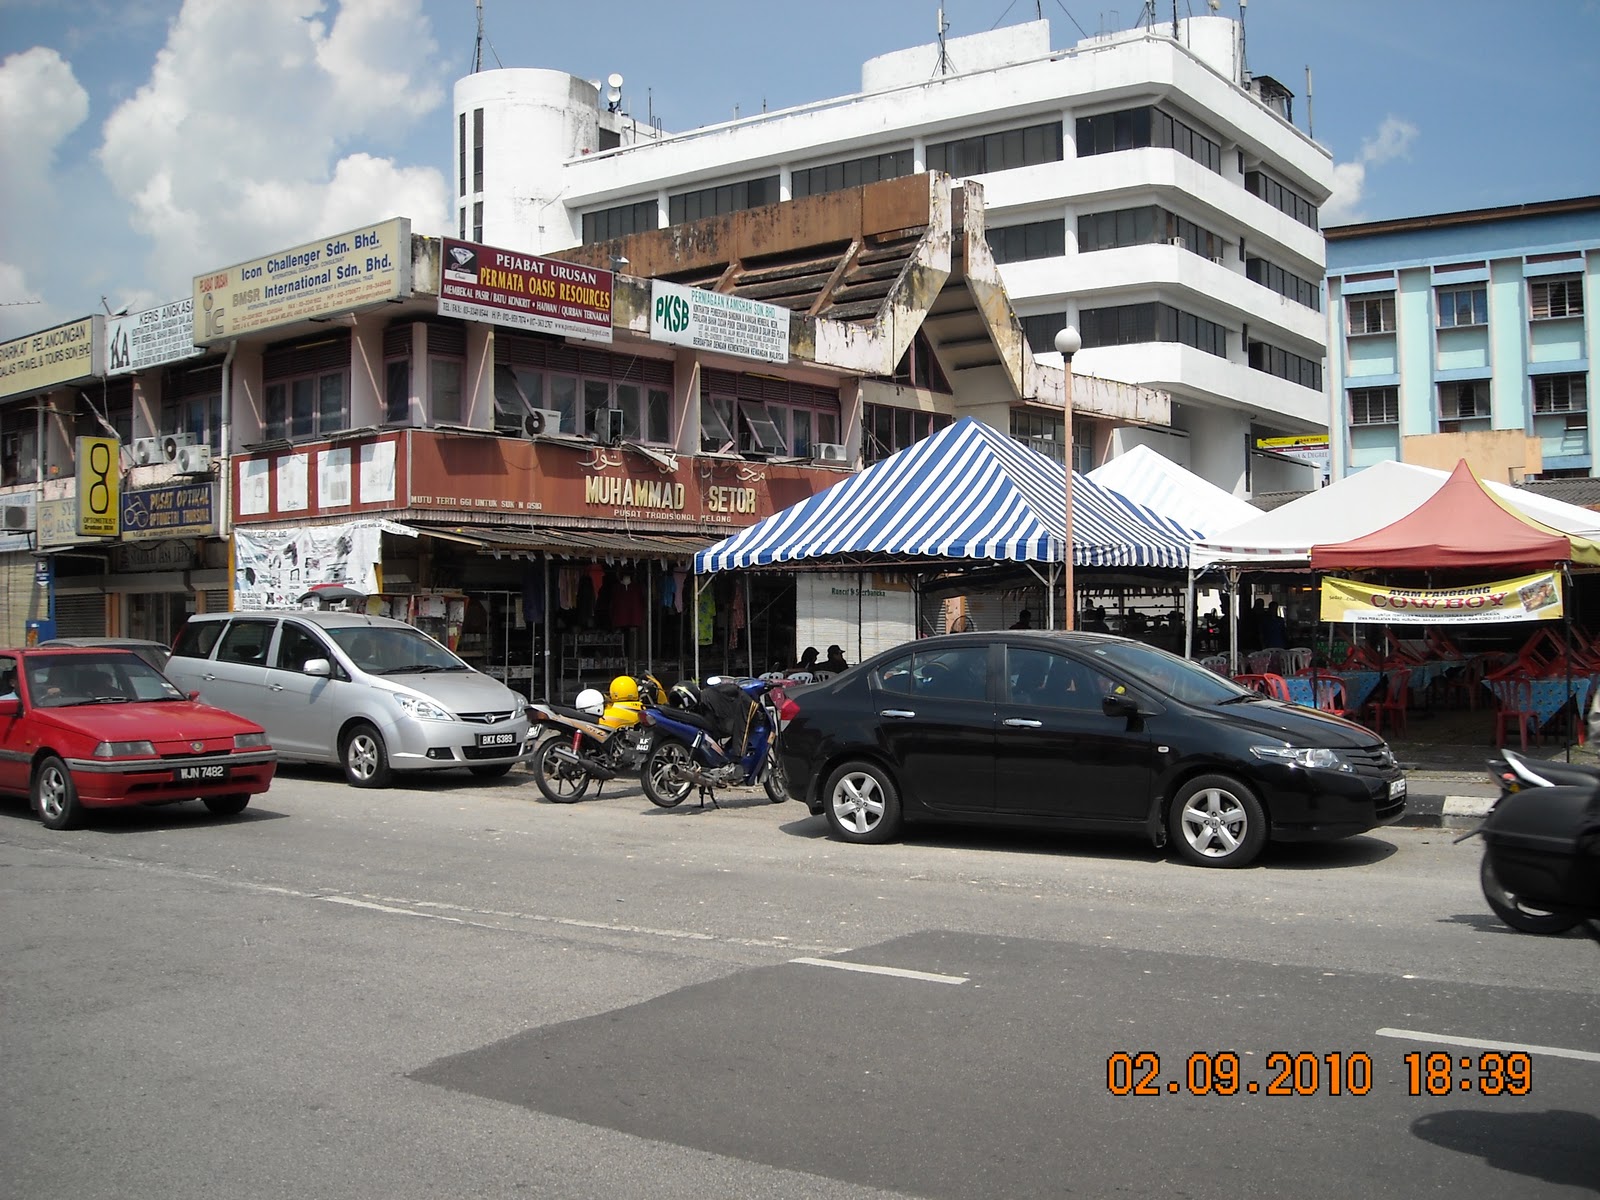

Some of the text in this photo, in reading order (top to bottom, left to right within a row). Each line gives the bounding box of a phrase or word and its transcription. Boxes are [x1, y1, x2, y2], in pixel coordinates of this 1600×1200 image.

[241, 266, 262, 280] Icon
[267, 250, 321, 274] Challenger
[326, 240, 350, 256] Sdn.
[354, 232, 379, 248] Bhd.
[496, 253, 596, 284] PEJABAT URUSAN
[232, 290, 260, 306] BMSR
[264, 271, 331, 297] International
[336, 263, 361, 279] Sdn.
[366, 255, 391, 271] Bhd.
[443, 284, 472, 297] MEMBEKAL
[480, 267, 523, 292] PERMATA
[528, 276, 555, 298] OASIS
[559, 282, 609, 308] RESOURCES
[139, 311, 158, 325] KERIS
[656, 295, 689, 332] PKSB
[0, 326, 85, 362] YARIKAT PELANCONGAN
[17, 359, 37, 373] TRAVEL
[39, 356, 43, 366] &
[45, 351, 62, 365] TOURS
[411, 495, 432, 504] MUTU
[475, 498, 497, 508] UNTUK
[585, 475, 756, 513] MUHAMMAD SETOR
[614, 509, 642, 518] PUSAT
[1389, 586, 1491, 598] AYAM PANGGANG
[496, 734, 513, 744] 6389
[181, 766, 224, 779] WJN 7482
